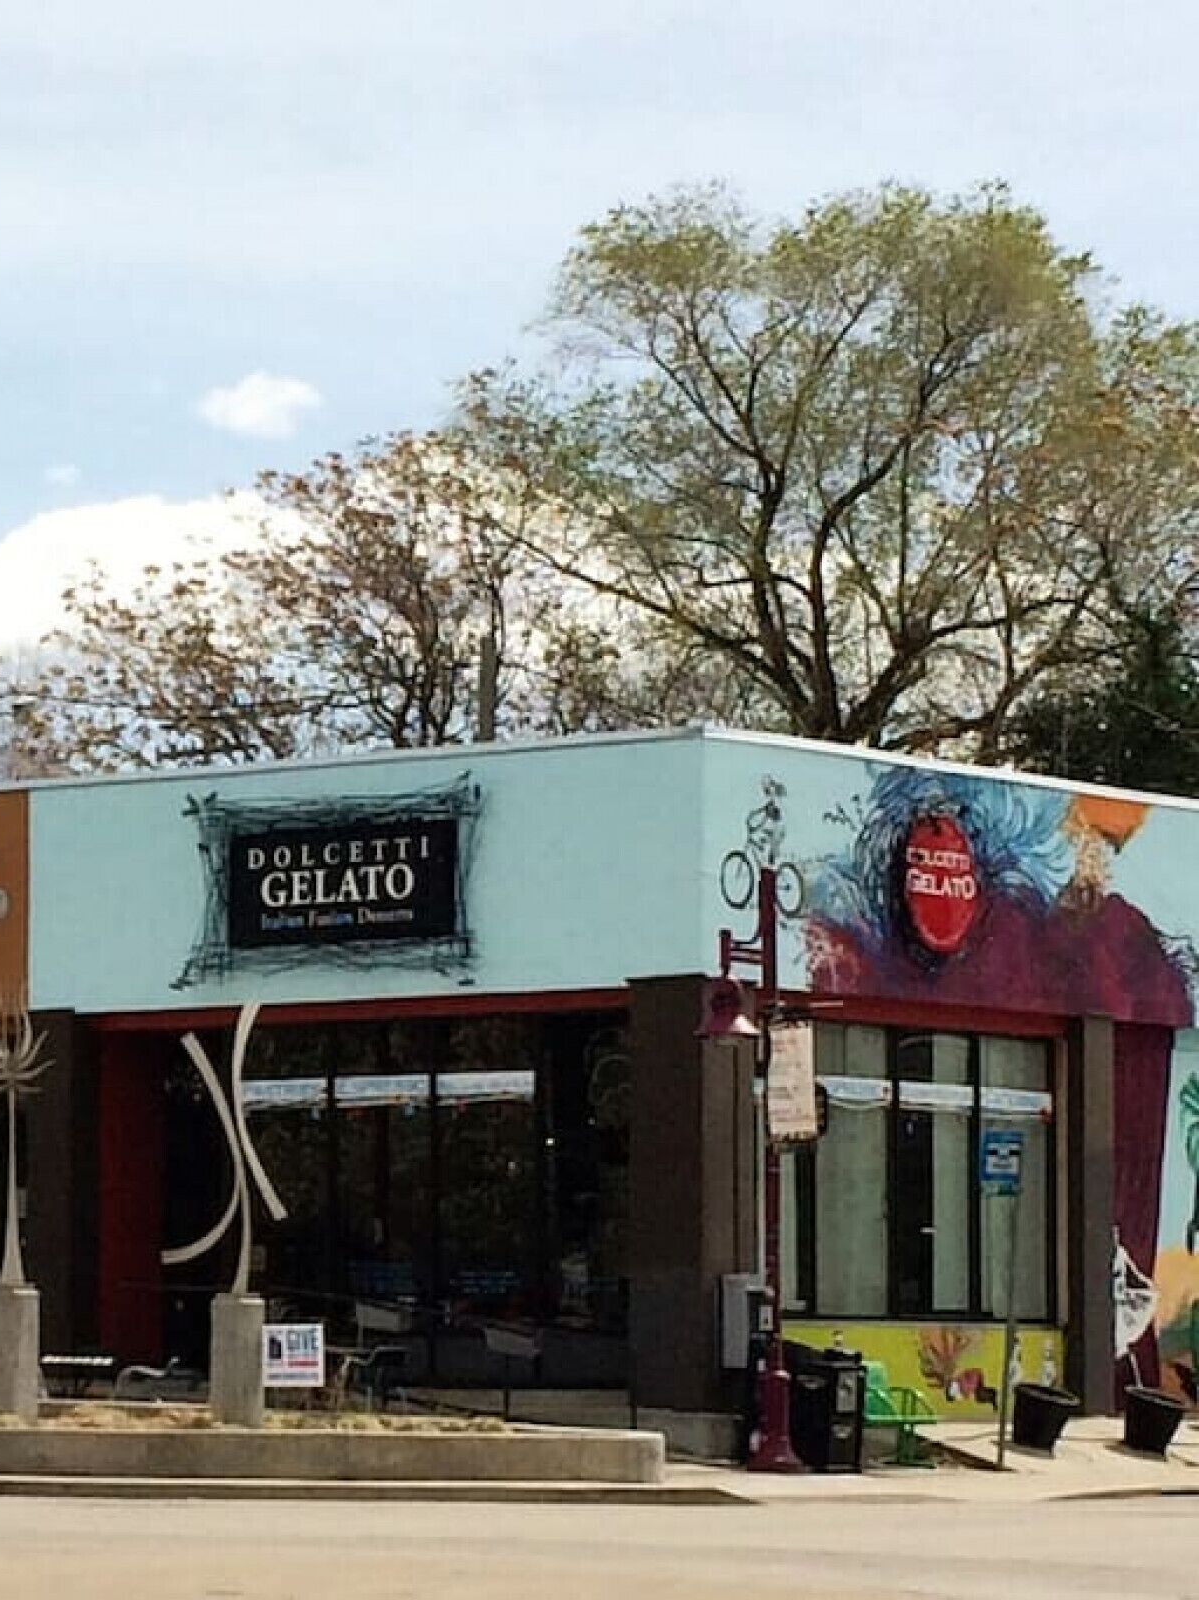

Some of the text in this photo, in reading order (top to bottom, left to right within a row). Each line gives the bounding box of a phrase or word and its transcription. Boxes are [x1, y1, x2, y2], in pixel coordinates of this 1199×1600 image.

[247, 835, 430, 870] DOLCETTI
[260, 862, 415, 908] GELATO
[905, 868, 976, 900] GELATO
